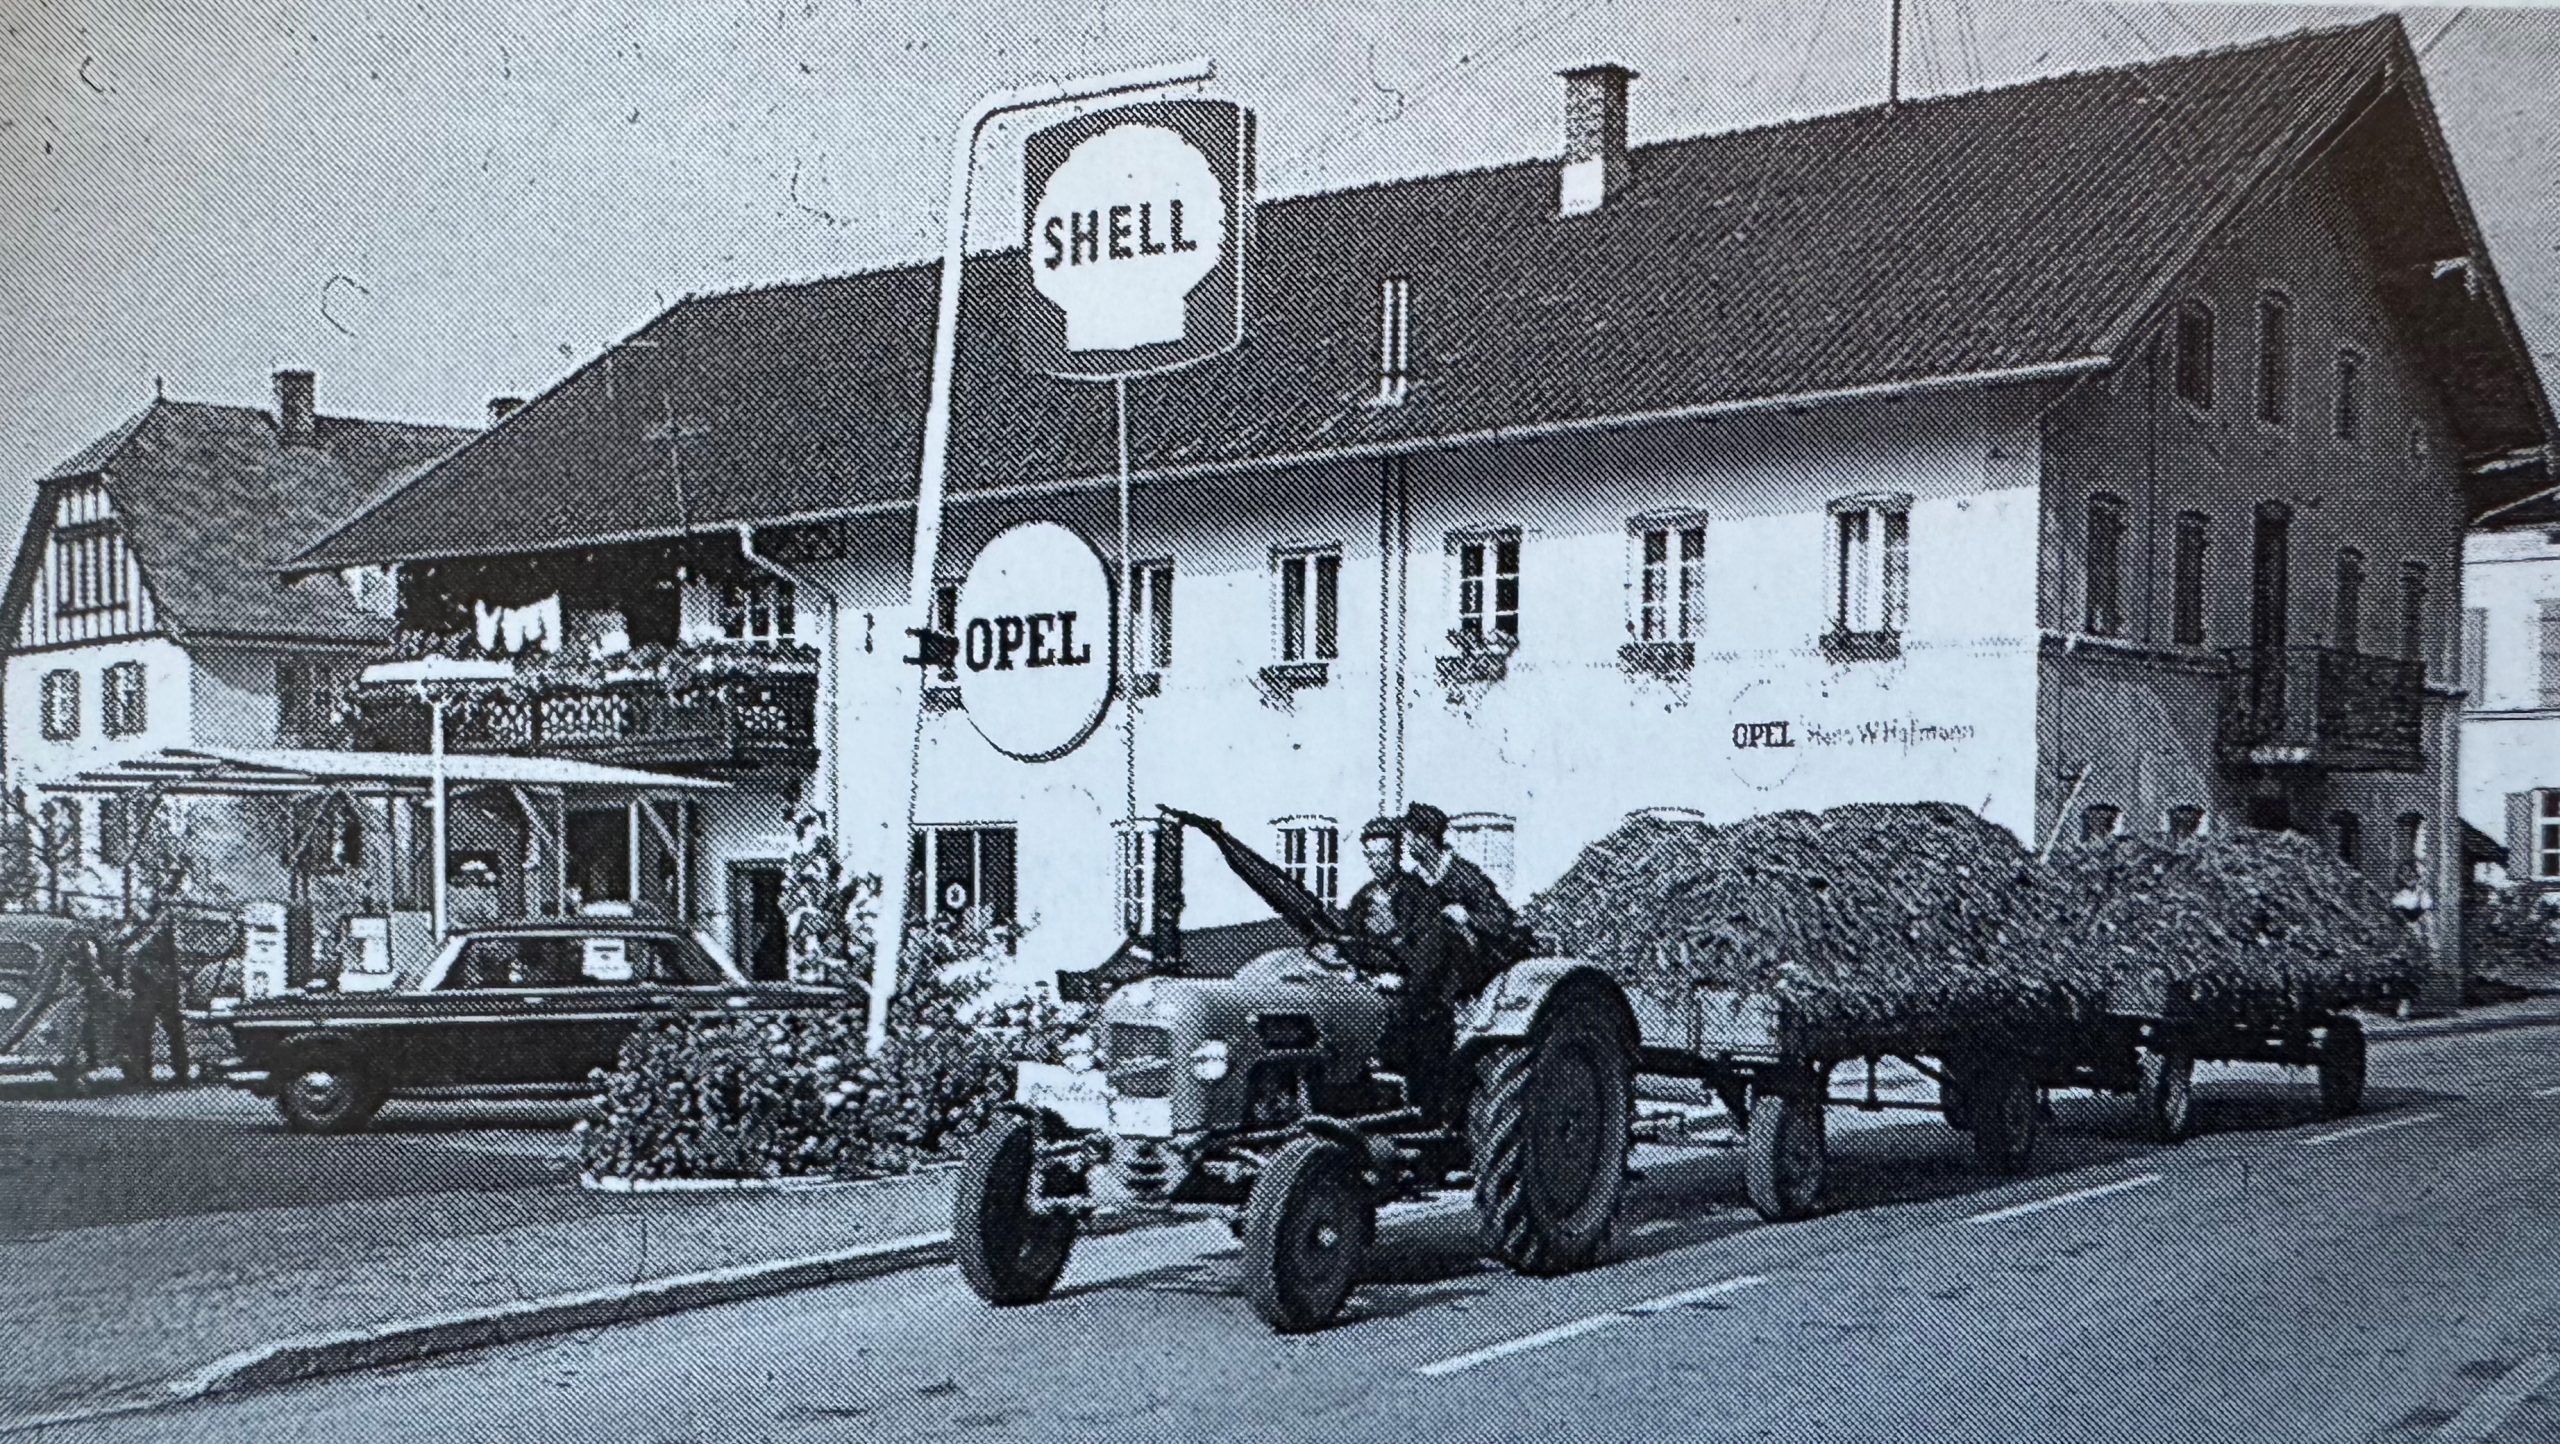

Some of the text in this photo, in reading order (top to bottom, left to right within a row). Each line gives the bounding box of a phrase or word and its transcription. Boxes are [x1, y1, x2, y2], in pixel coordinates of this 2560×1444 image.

[1043, 199, 1197, 270] SHELL
[966, 611, 1091, 672] OPEL
[1732, 720, 1796, 749] OPEL
